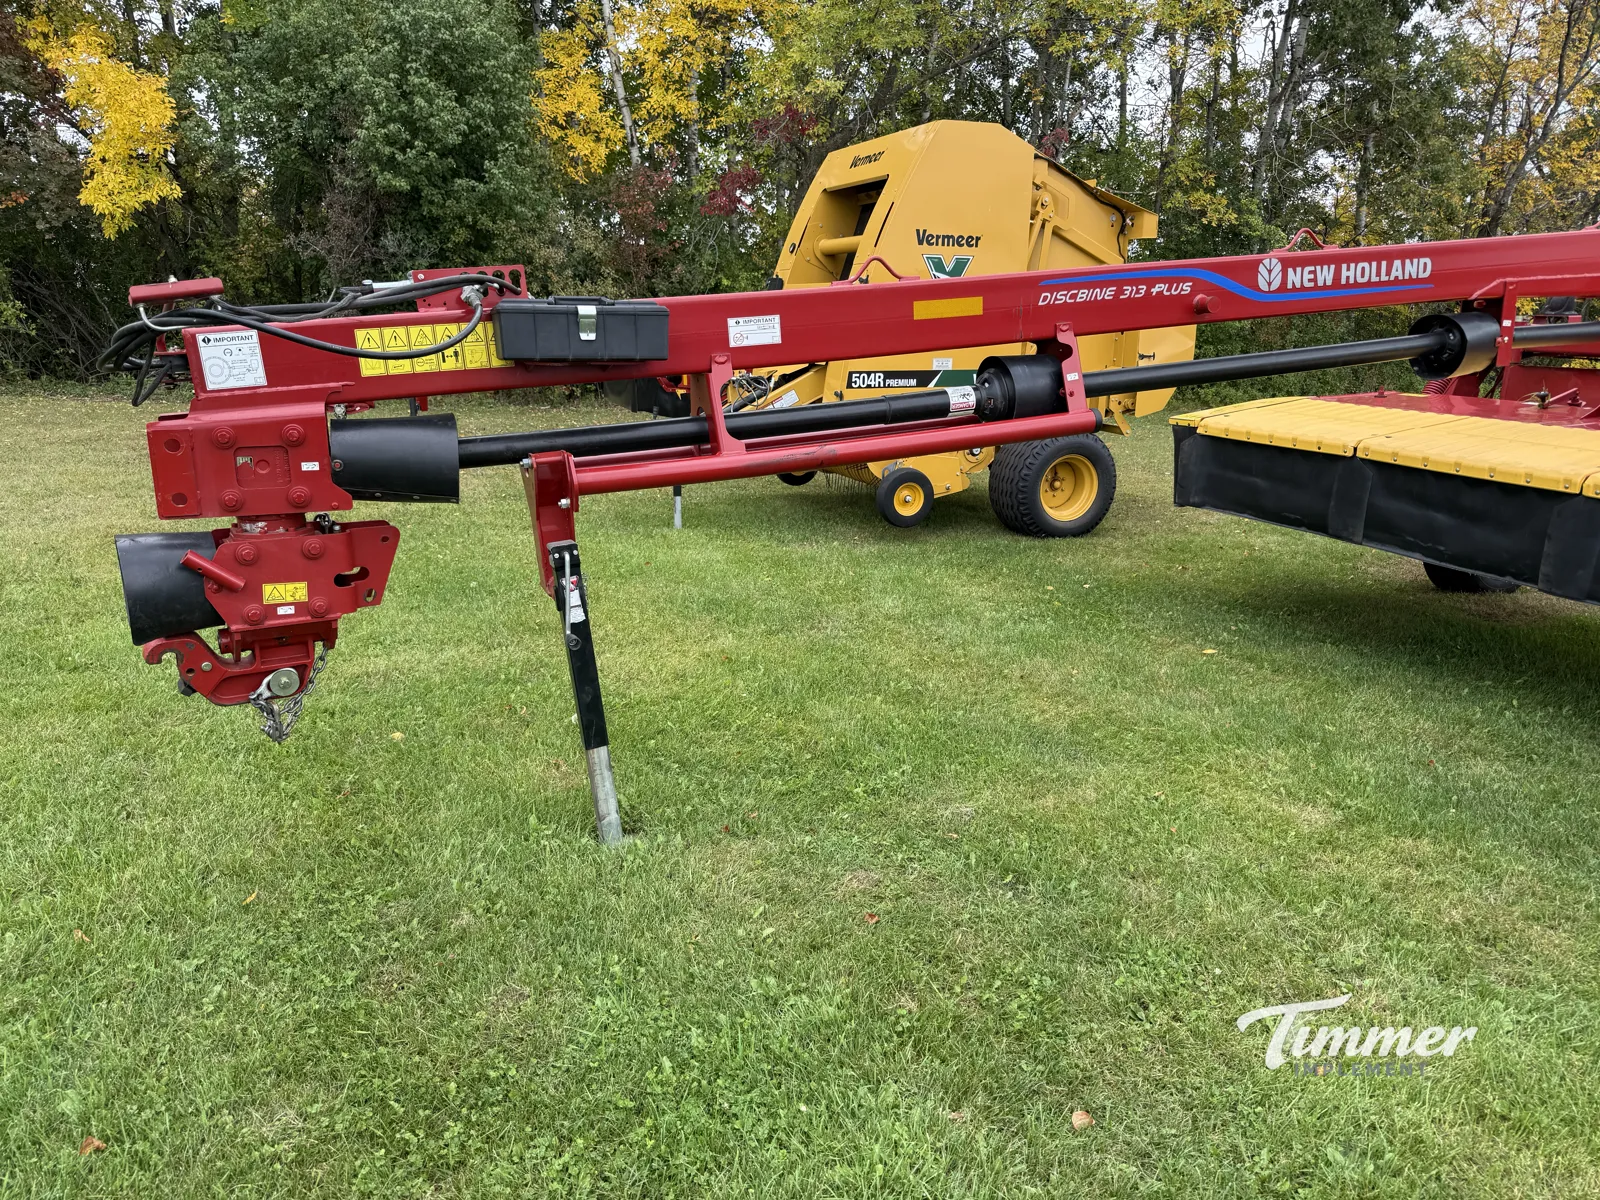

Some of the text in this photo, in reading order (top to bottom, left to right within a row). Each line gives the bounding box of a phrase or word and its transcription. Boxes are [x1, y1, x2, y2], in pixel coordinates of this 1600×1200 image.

[849, 150, 886, 169] Vermeer
[915, 228, 982, 248] Vermeer
[1286, 257, 1432, 289] NEW HOLLAND
[1037, 286, 1117, 306] DISCBINE
[1119, 285, 1147, 299] 313
[742, 317, 776, 325] IMPORTANT
[212, 334, 254, 344] IMPORTANT
[851, 372, 917, 388] 504R PREMIUM
